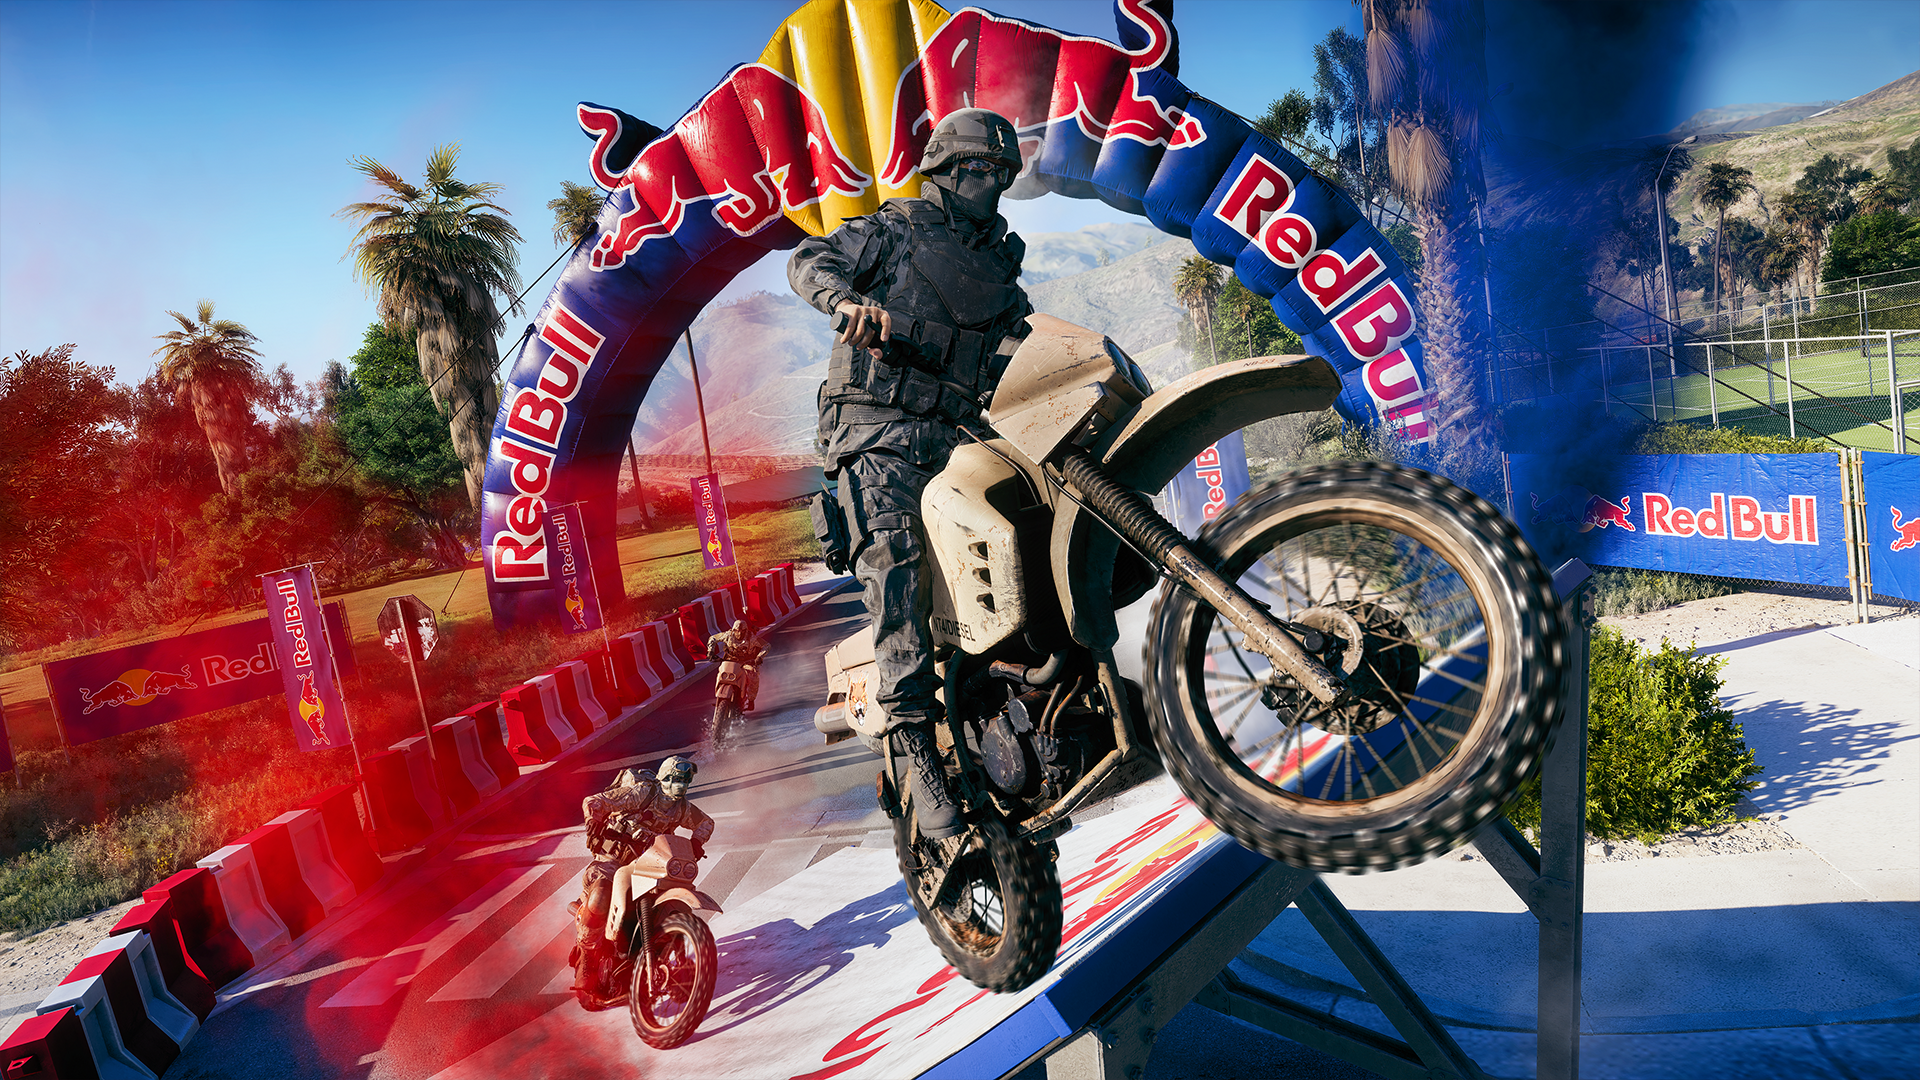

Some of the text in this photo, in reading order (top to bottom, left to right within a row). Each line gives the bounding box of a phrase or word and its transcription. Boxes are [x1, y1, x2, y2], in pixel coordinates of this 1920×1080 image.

[1213, 153, 1432, 444] Red Bull
[493, 300, 606, 582] Red Bull
[698, 478, 716, 525] Red Bull
[1195, 468, 1227, 521] Red
[1642, 492, 1819, 546] Red Bull
[552, 513, 576, 576] Red Bull
[276, 578, 312, 668] Red Bull
[201, 642, 274, 687] Red
